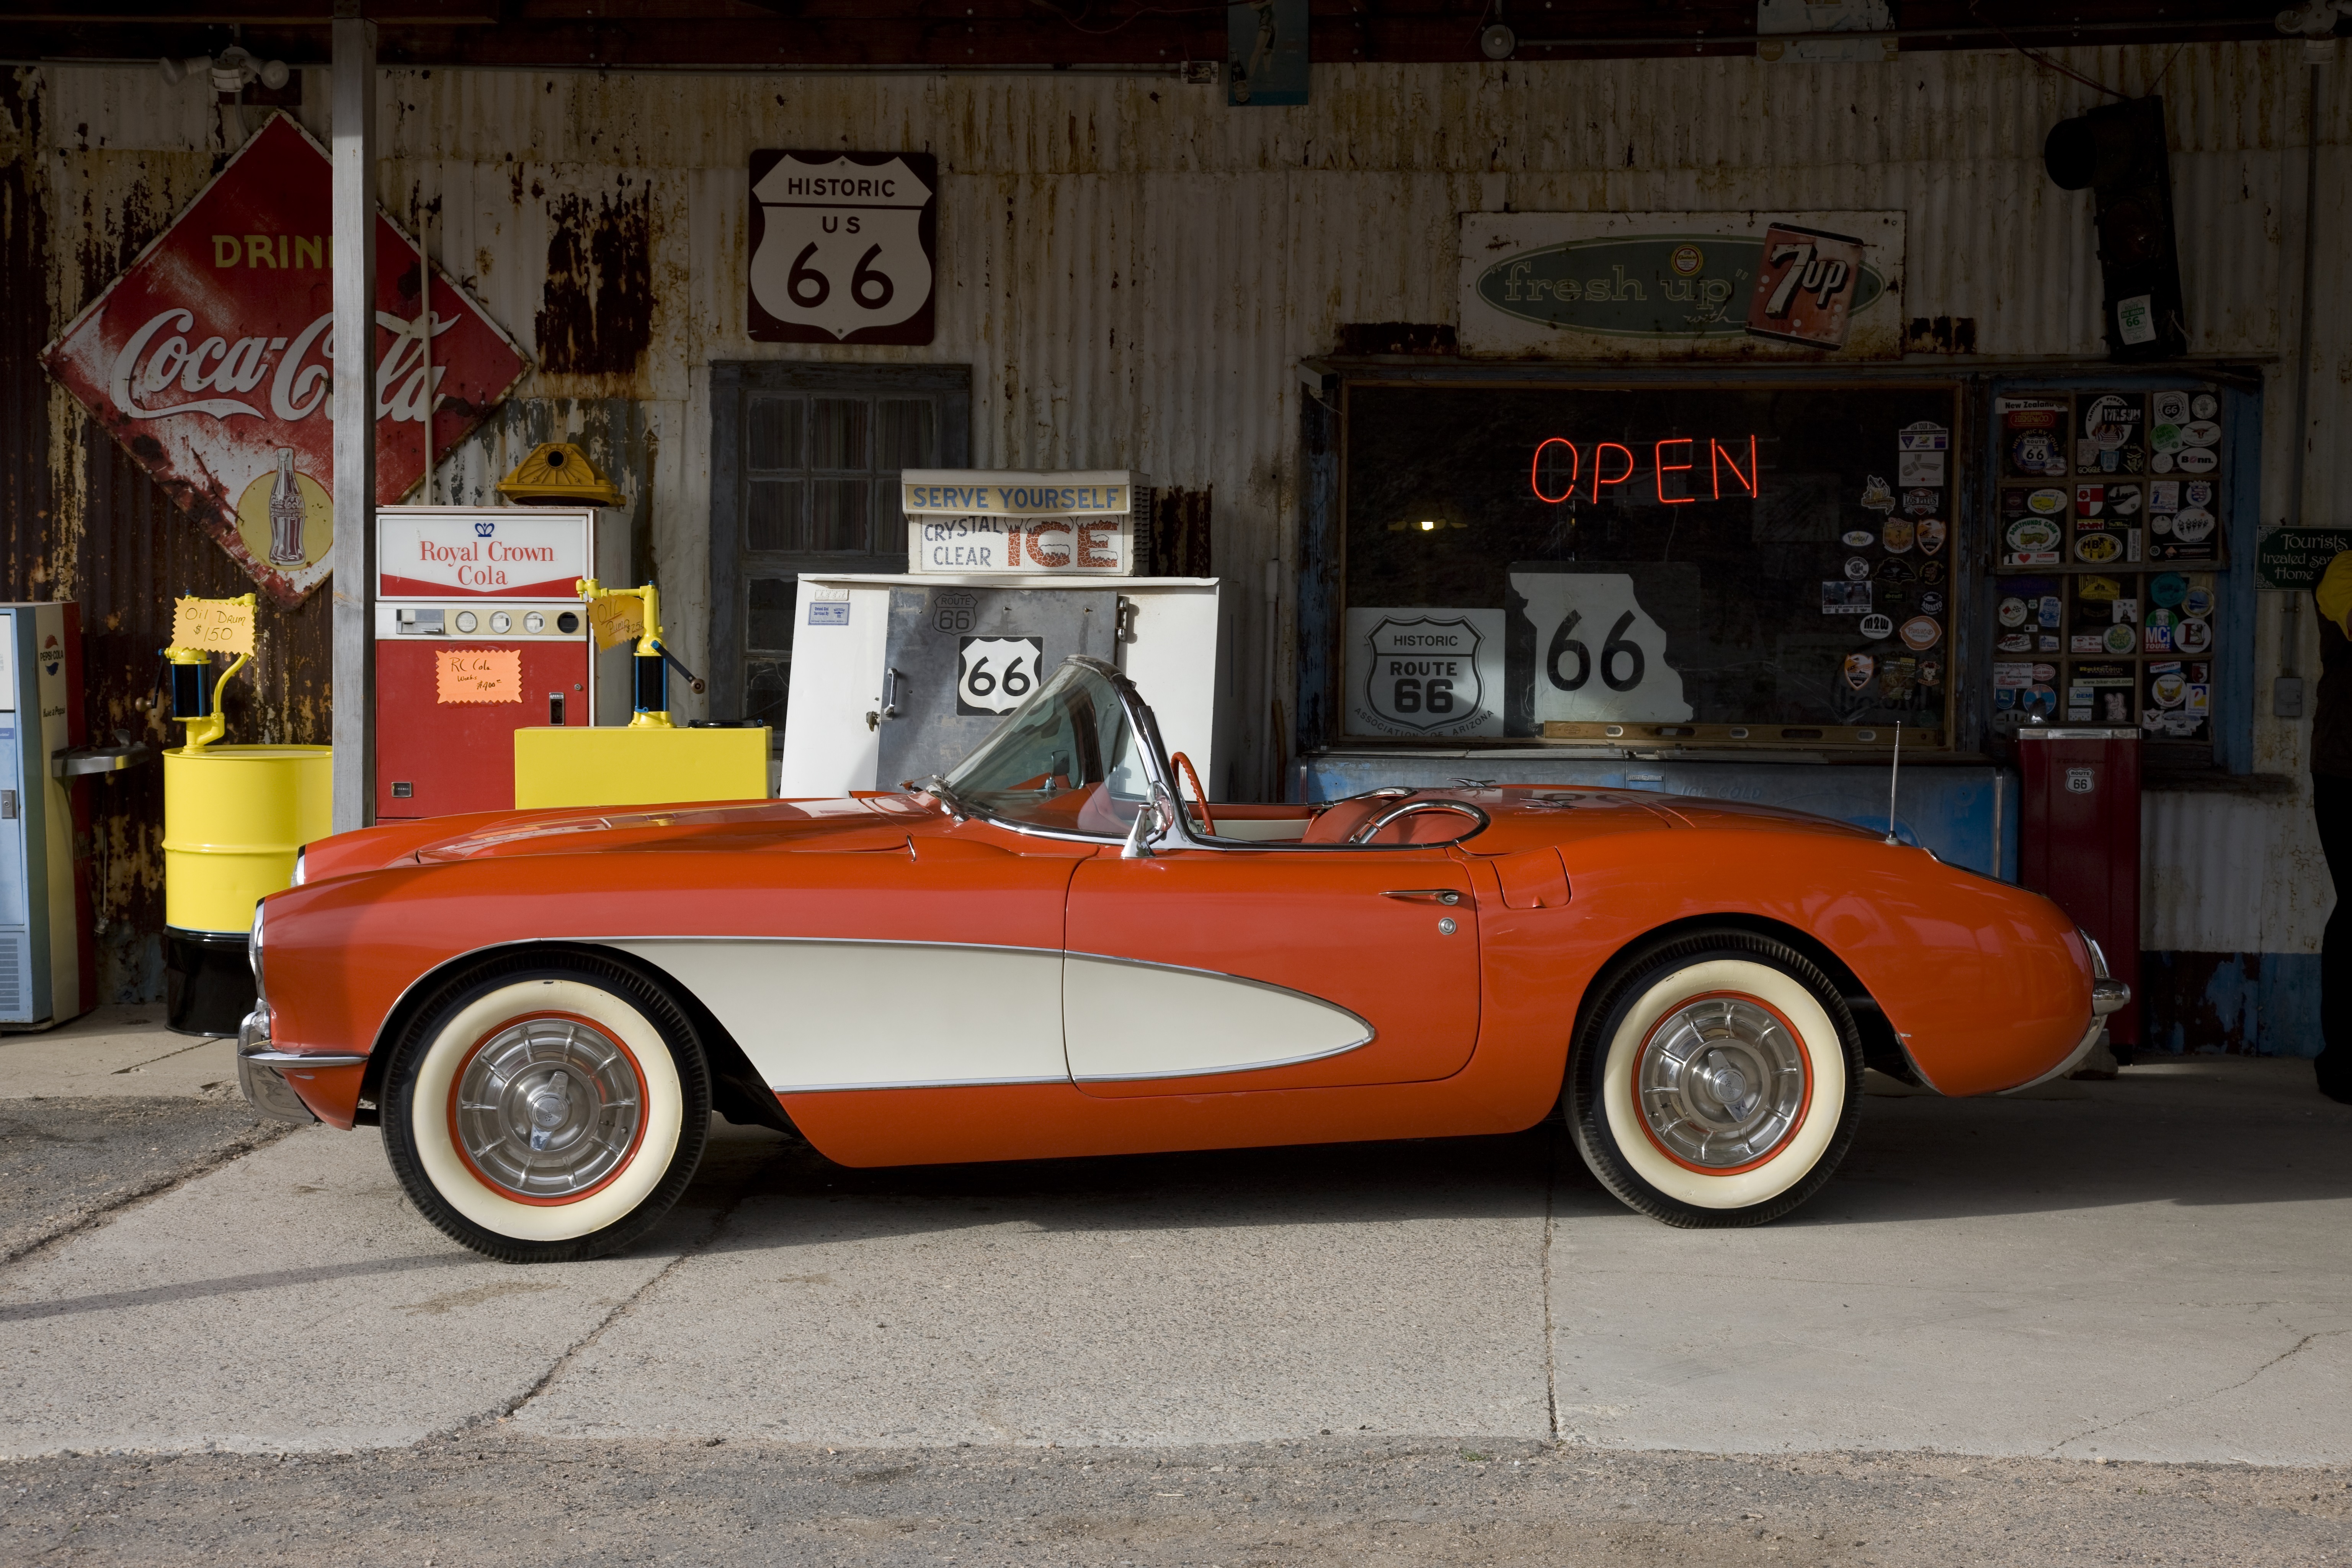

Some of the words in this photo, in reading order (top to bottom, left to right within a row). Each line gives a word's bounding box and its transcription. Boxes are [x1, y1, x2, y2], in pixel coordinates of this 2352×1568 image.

[788, 178, 895, 197] HISTORIC
[822, 216, 860, 234] US
[212, 235, 333, 269] DRIN
[787, 241, 893, 309] 66
[1684, 309, 1740, 323] with
[2126, 316, 2140, 327] 66
[109, 307, 461, 421] Coca-Cla
[2088, 400, 2102, 421] CAMPING
[2165, 406, 2178, 415] 66
[2012, 429, 2037, 449] HISTORIC
[2048, 434, 2059, 452] TOUR
[2026, 449, 2043, 460] 66
[1531, 433, 1757, 504] OPEN
[913, 487, 988, 508] SERVE
[998, 488, 1119, 509] YOURSELF
[1905, 496, 1918, 504] LOS
[2010, 519, 2042, 536] DORTMUNDS
[2043, 521, 2058, 534] GRÜN
[924, 516, 1003, 541] CRYSTAL
[1005, 516, 1120, 568] ICE
[2280, 533, 2349, 554] Tourists
[420, 541, 479, 567] Royal
[488, 541, 554, 562] Crown
[934, 546, 991, 567] CLEAR
[2008, 554, 2014, 564] I
[2263, 552, 2306, 565] treated
[457, 565, 508, 586] Cola
[2274, 567, 2314, 581] Home
[185, 608, 208, 620] Oil
[939, 609, 970, 630] 66
[1394, 635, 1458, 646] HISTORIC
[40, 650, 64, 662] PEPSI-COLA
[1547, 609, 1645, 692] 66
[449, 657, 467, 672] RC
[472, 658, 492, 670] Cola
[1390, 661, 1457, 676] ROUTE
[968, 656, 1031, 697] 66
[1395, 678, 1454, 714] 66
[43, 708, 52, 717] Have
[55, 706, 66, 717] Pepsi
[1354, 708, 1419, 737] ASSOCIATION
[1453, 710, 1494, 736] ARIZONA
[2073, 779, 2087, 789] 66
